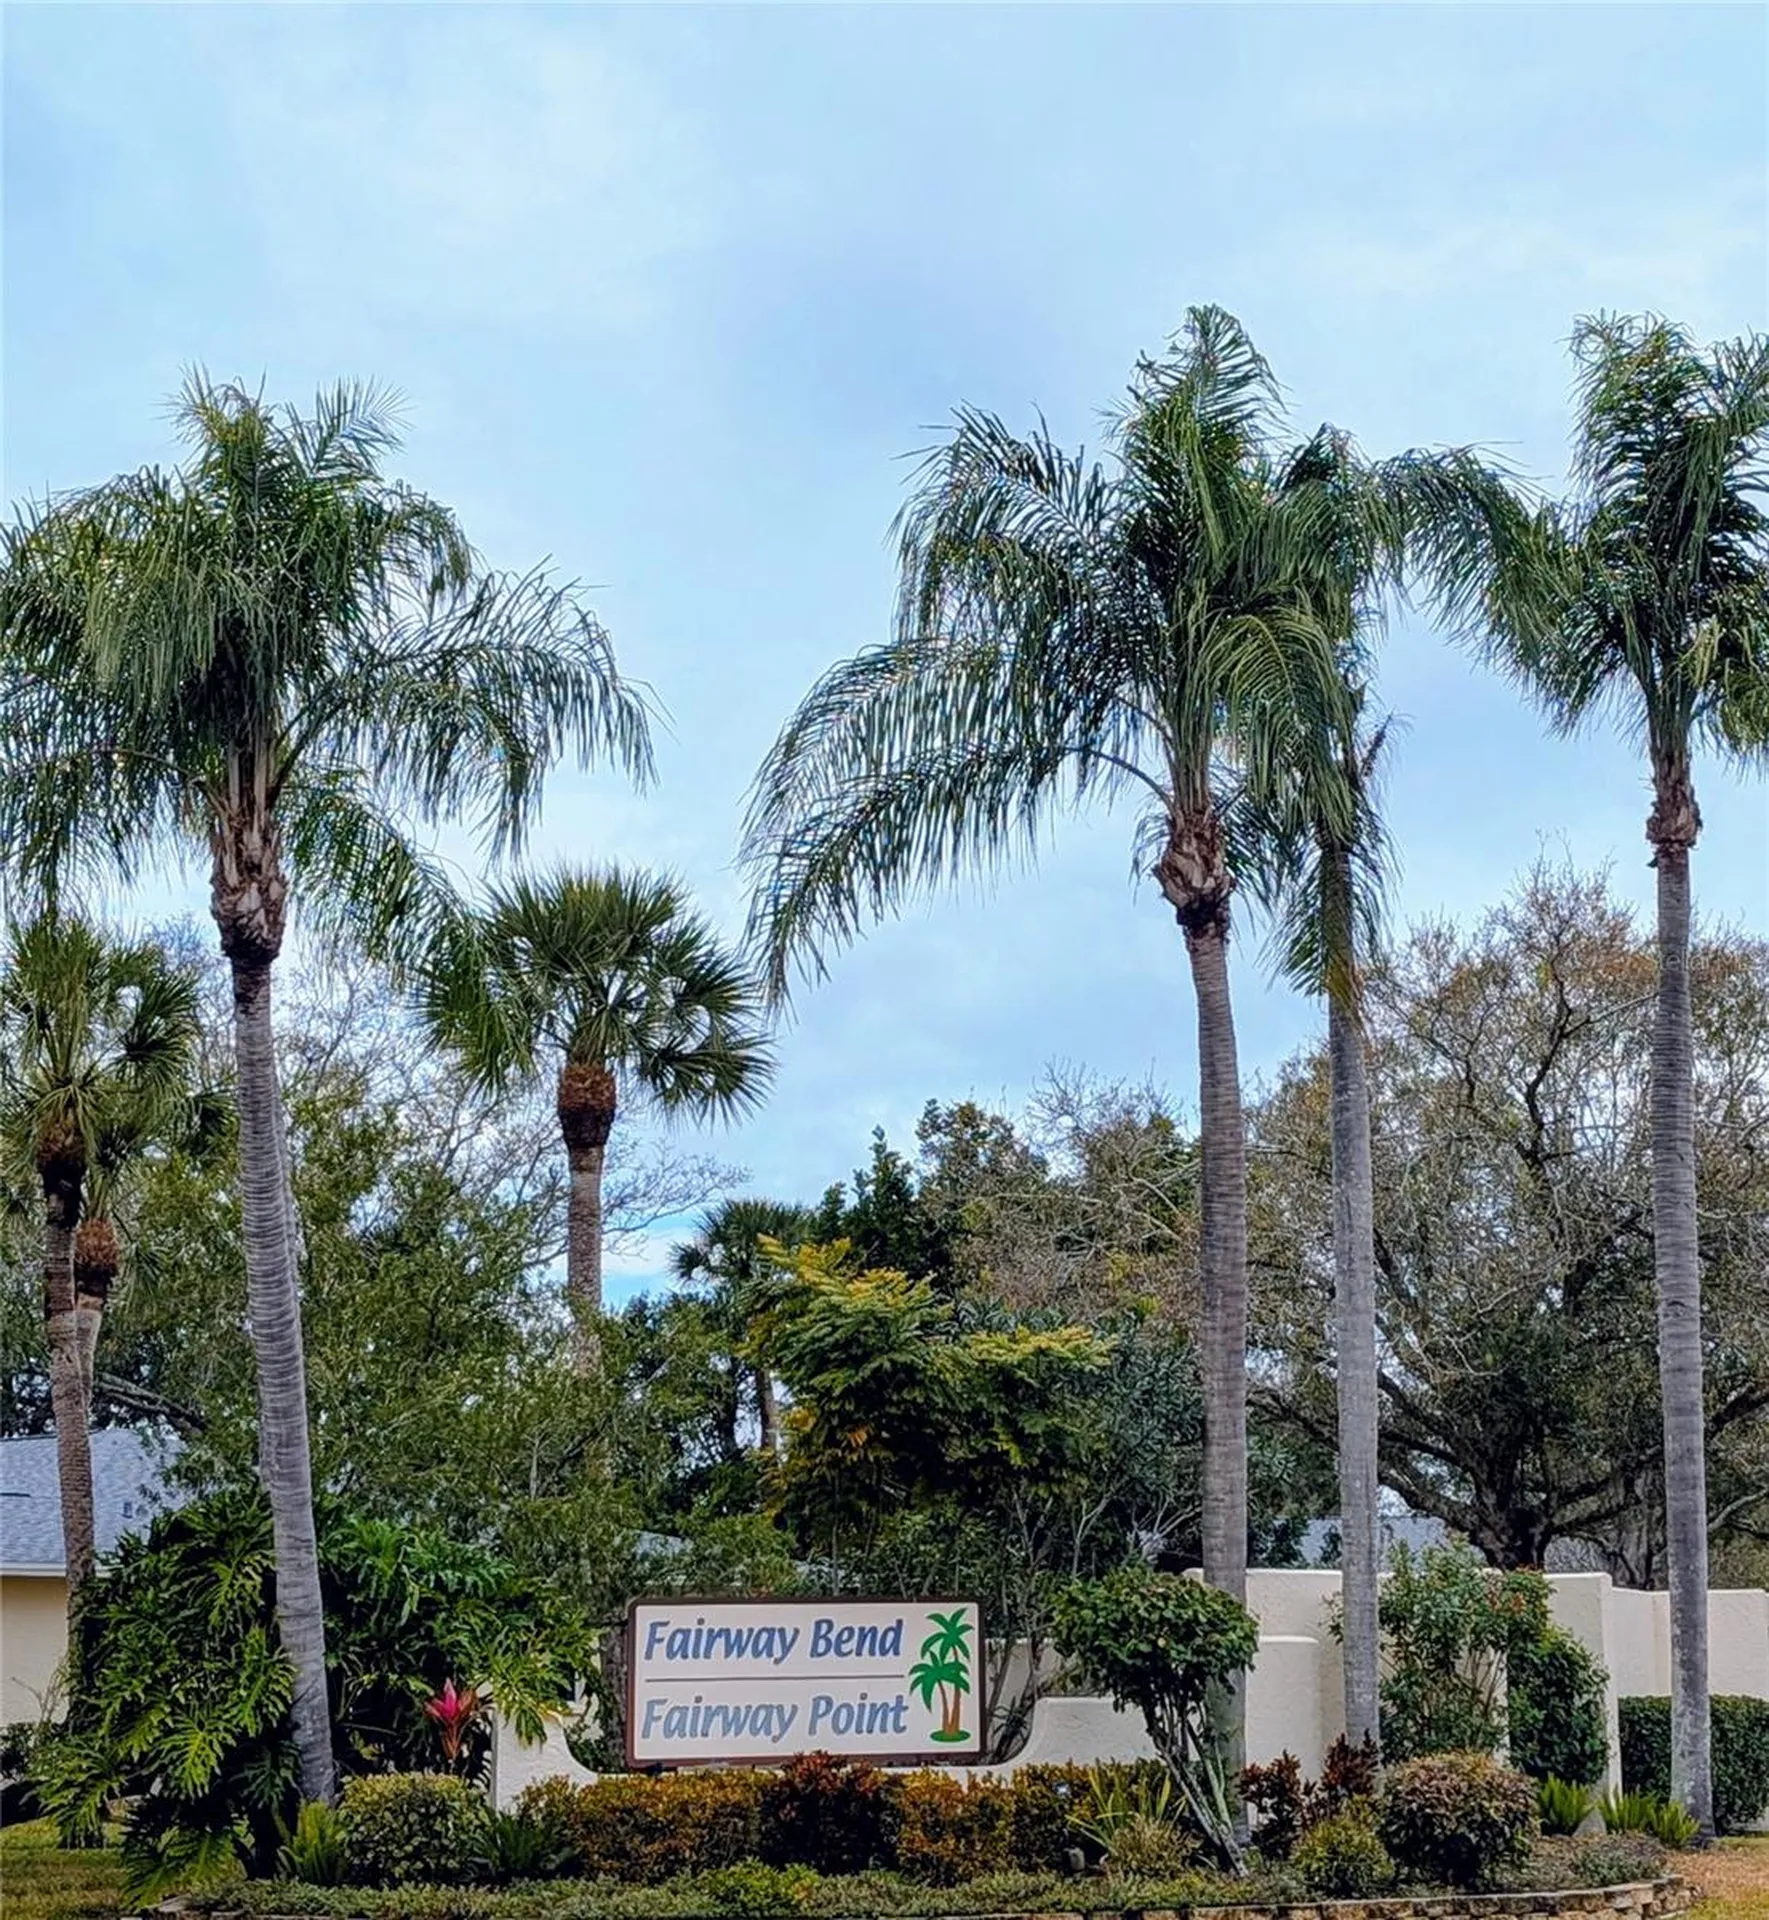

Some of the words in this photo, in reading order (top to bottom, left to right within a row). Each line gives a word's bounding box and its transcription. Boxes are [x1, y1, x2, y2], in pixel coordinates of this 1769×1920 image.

[644, 1618, 800, 1665] Fairway
[809, 1618, 904, 1658] Bend
[641, 1695, 798, 1743] Fairway
[808, 1692, 909, 1735] Point
